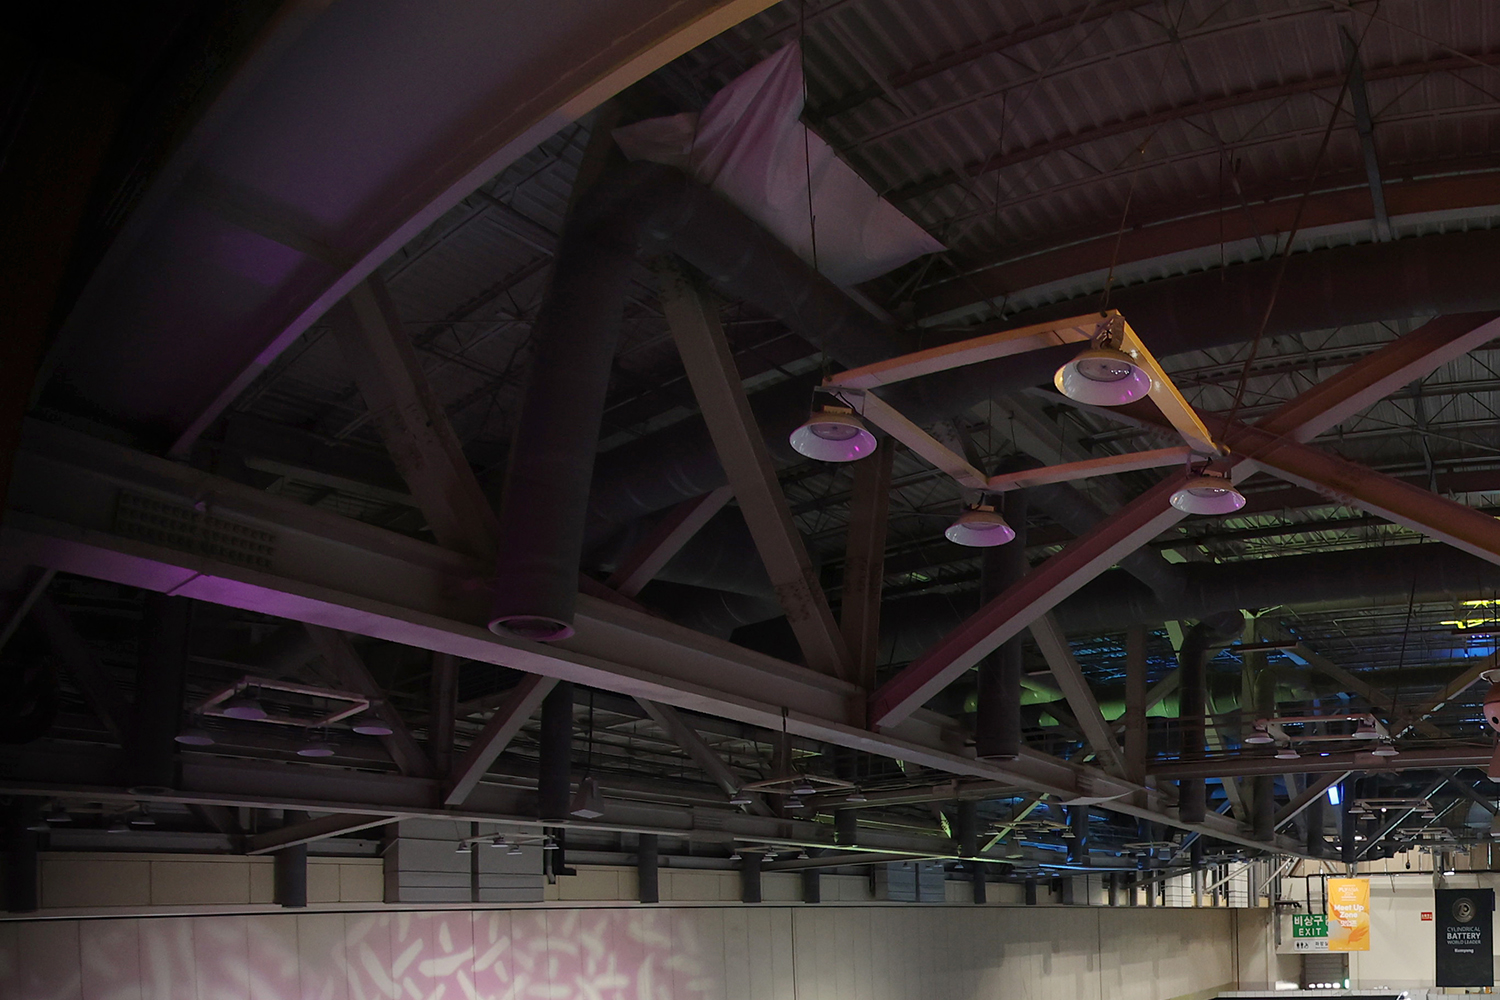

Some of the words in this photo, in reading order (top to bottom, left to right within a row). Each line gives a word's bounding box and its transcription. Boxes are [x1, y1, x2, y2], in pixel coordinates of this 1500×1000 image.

[1353, 905, 1364, 913] Up
[1294, 916, 1323, 926] 비상구
[1298, 928, 1321, 936] EXIT
